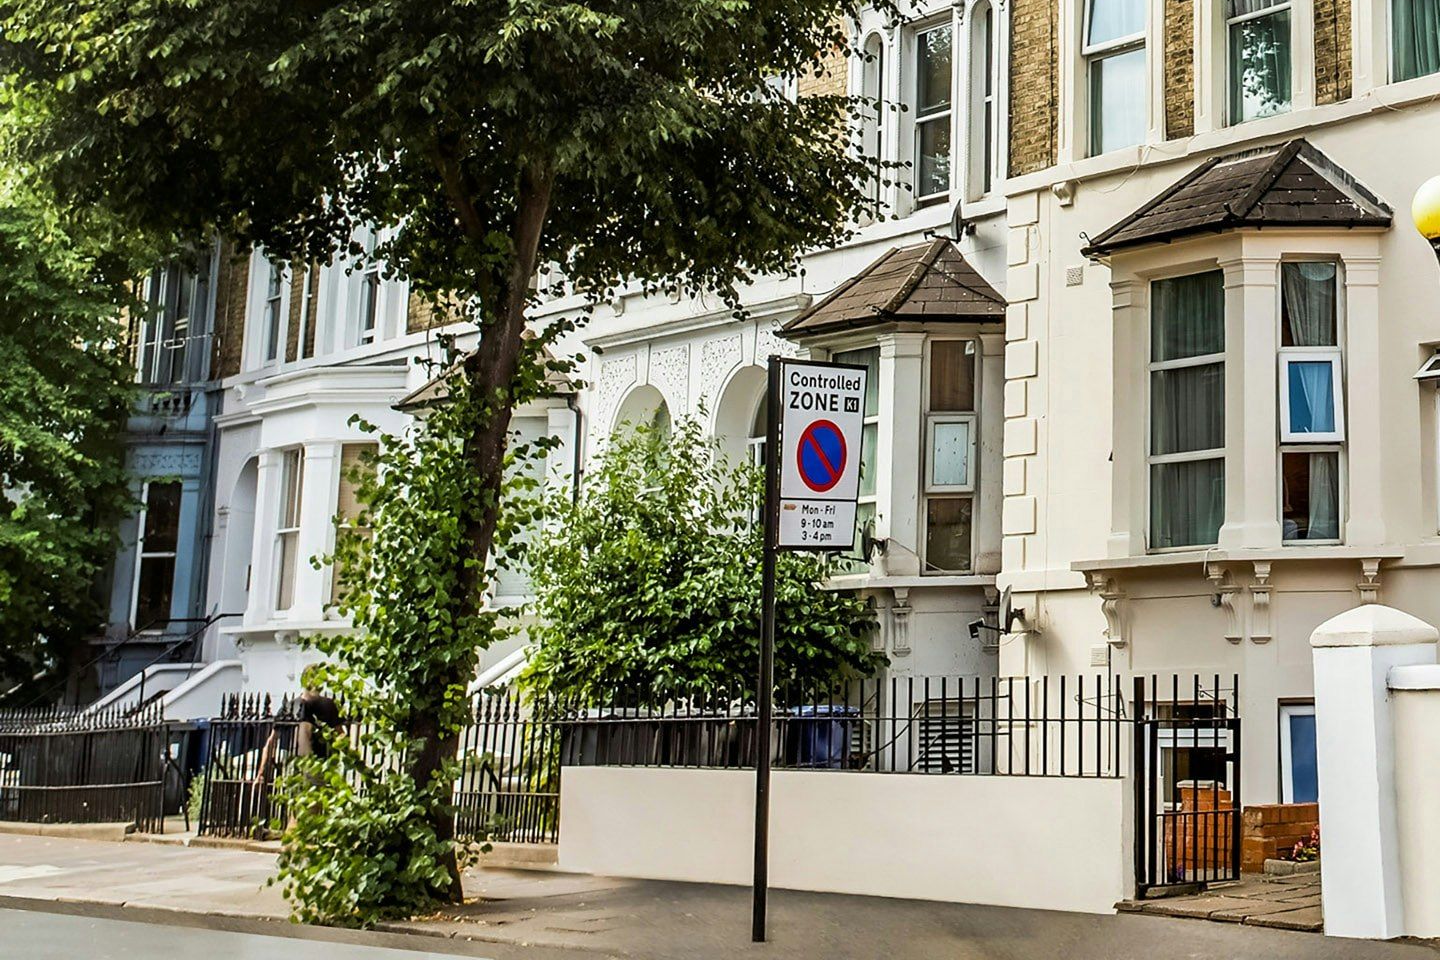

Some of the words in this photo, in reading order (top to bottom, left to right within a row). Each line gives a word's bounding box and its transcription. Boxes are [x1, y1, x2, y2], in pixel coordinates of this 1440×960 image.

[790, 371, 860, 391] Controlled
[790, 391, 838, 412] ZONE
[845, 398, 858, 411] K1
